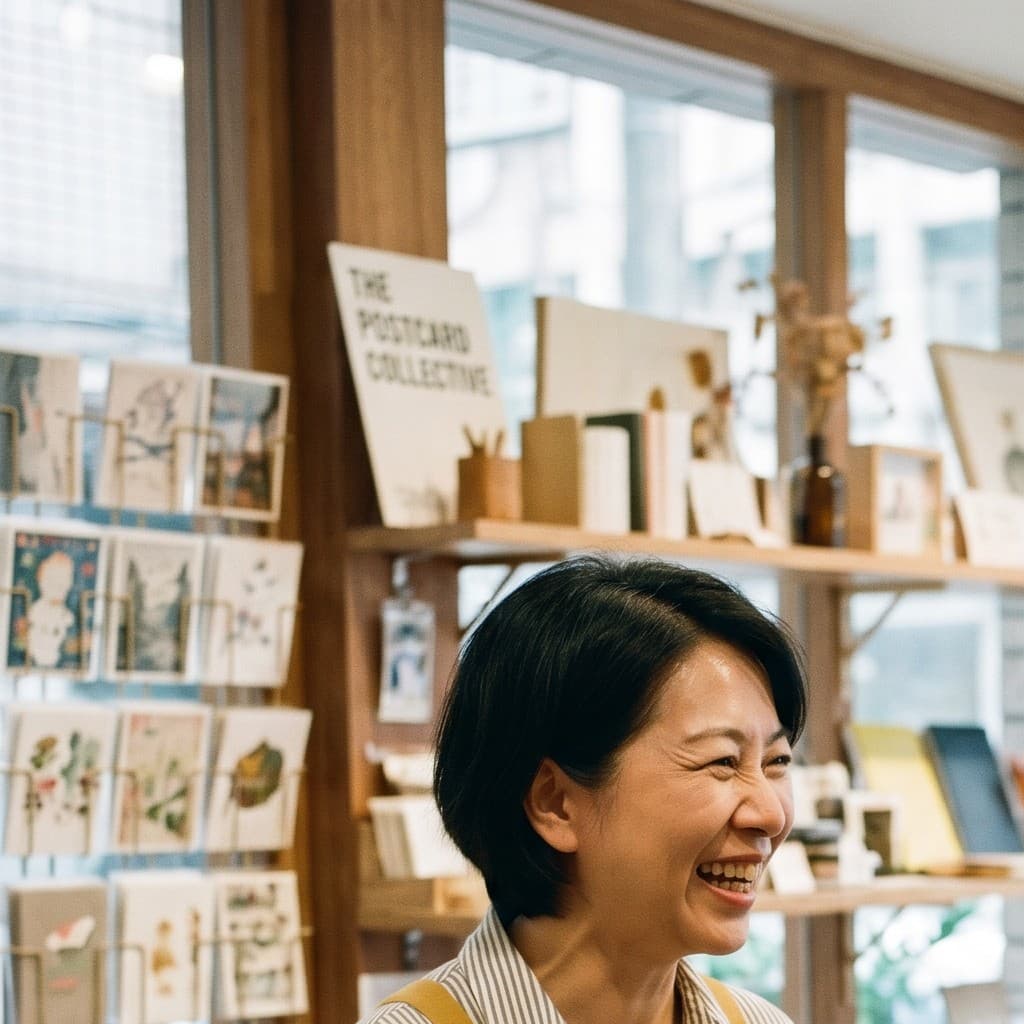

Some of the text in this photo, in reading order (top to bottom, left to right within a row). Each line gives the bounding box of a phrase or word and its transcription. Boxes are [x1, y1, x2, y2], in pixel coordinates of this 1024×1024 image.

[348, 267, 392, 303] THE
[356, 309, 471, 353] POSTCARD
[365, 352, 491, 397] COLLECTIVE
